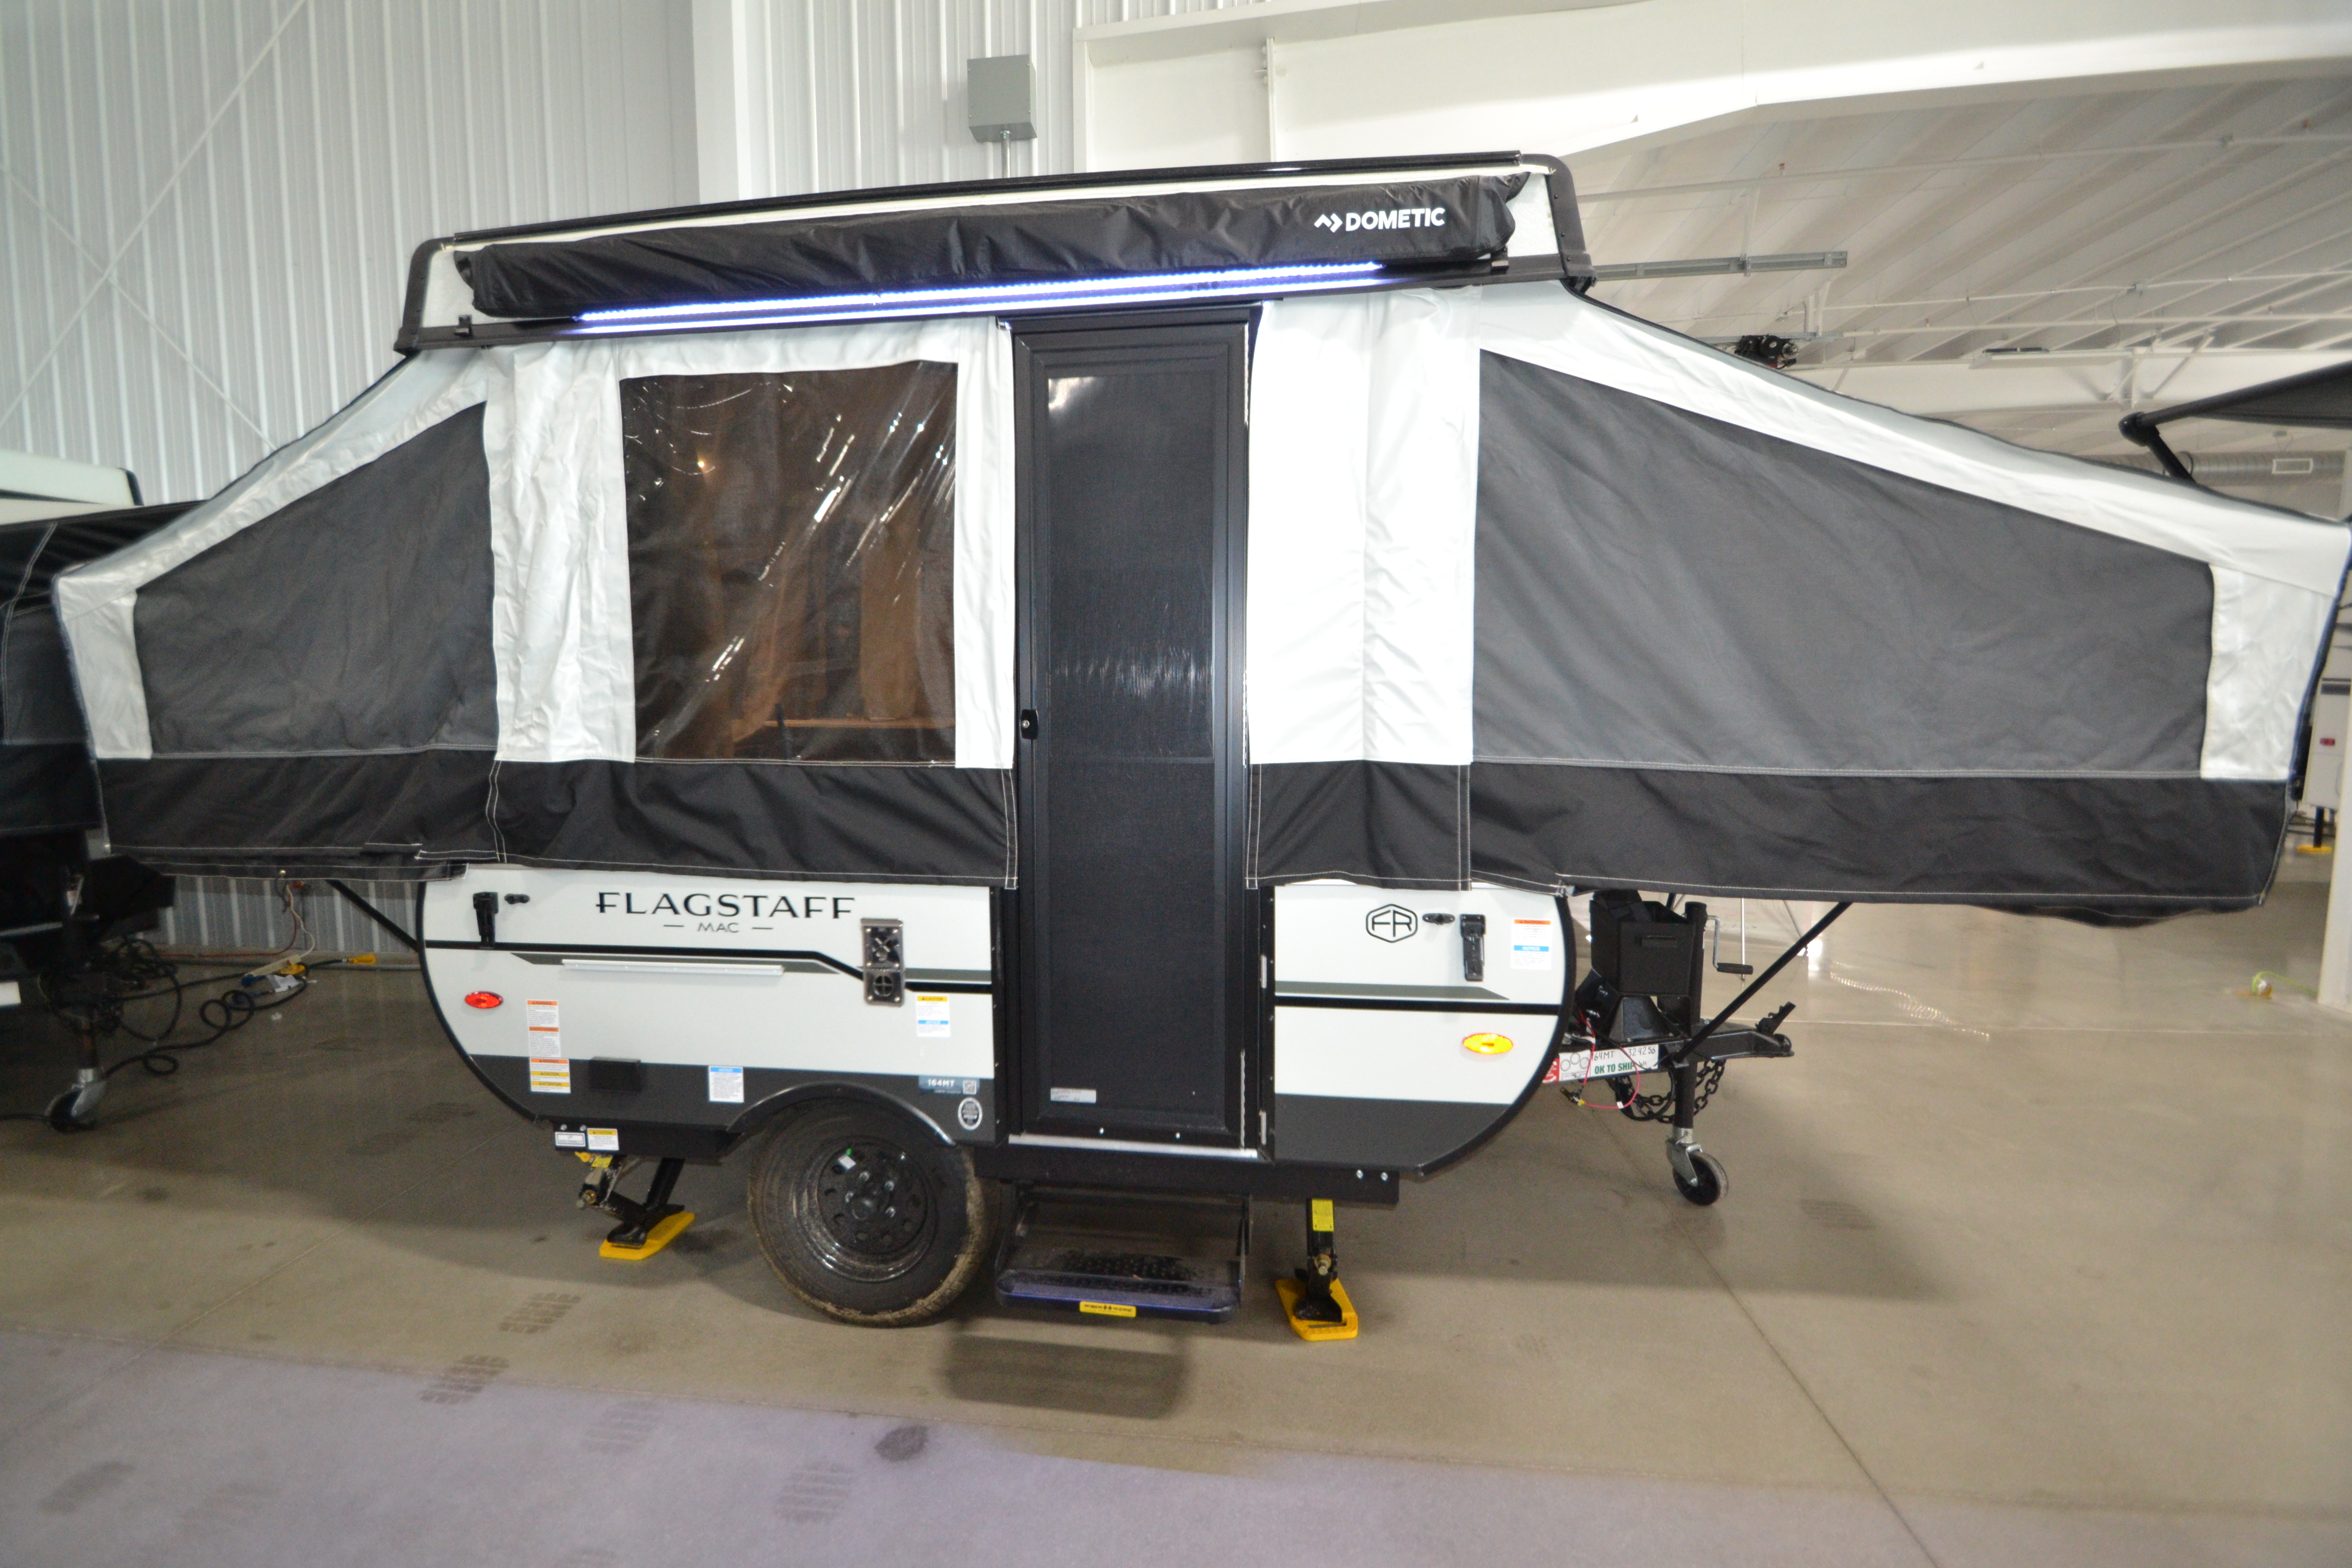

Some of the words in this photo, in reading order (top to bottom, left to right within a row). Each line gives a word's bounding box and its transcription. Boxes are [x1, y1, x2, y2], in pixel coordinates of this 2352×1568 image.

[1345, 207, 1446, 232] DOMETIC
[596, 892, 855, 919] FLAGSTAFF
[697, 922, 739, 933] MAC
[1371, 909, 1412, 938] FR
[1595, 1065, 1605, 1074] OK
[1607, 1064, 1616, 1072] TO
[1618, 1062, 1635, 1071] SHIP
